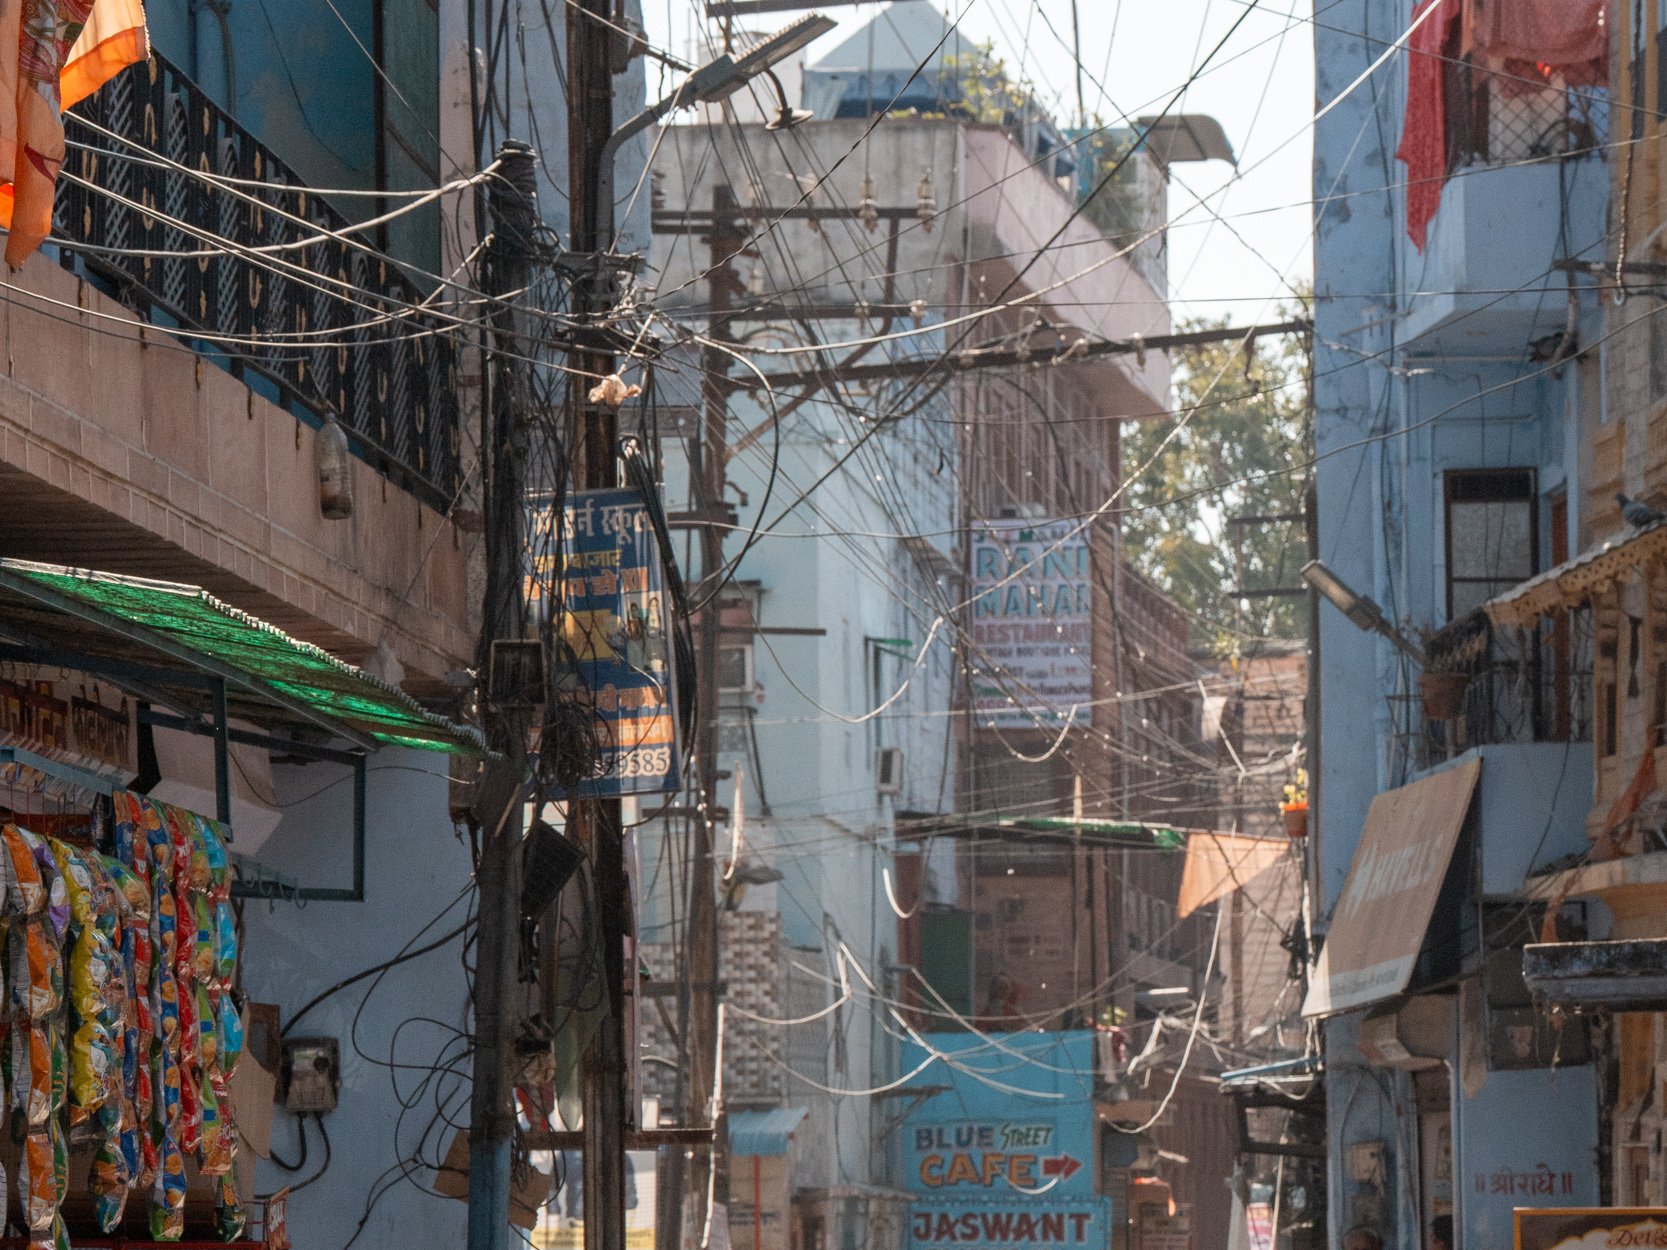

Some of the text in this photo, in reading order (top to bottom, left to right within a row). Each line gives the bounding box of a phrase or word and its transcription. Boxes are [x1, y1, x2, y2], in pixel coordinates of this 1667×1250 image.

[976, 546, 1090, 580] RANI
[975, 583, 1090, 618] MAHAL
[915, 1126, 995, 1150] BLUE
[919, 1153, 1037, 1187] CAFE
[912, 1211, 1092, 1244] JASWANT
